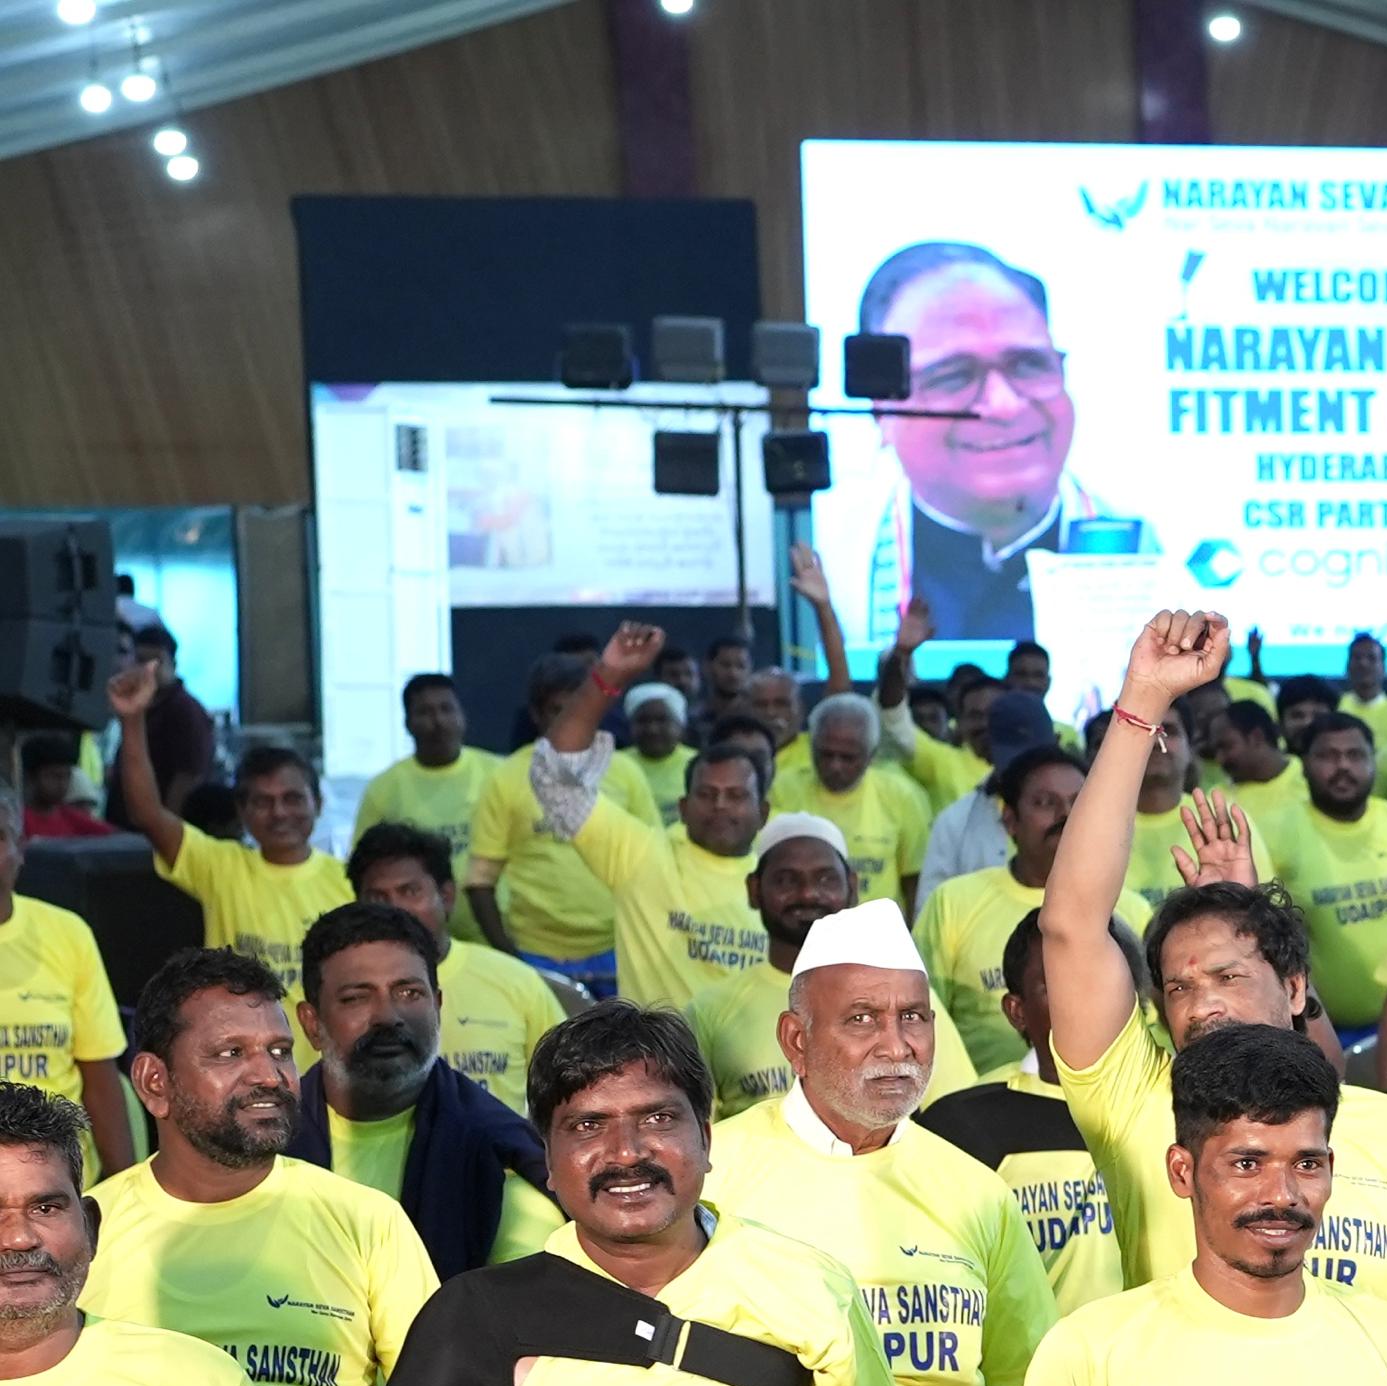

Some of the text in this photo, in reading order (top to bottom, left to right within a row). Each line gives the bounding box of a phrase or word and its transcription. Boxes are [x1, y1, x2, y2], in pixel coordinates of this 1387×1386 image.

[1162, 179, 1309, 211] NARAYAN
[1165, 326, 1387, 374] NARAYAN
[1169, 387, 1380, 435] FITMENT
[1243, 500, 1306, 528] CSR
